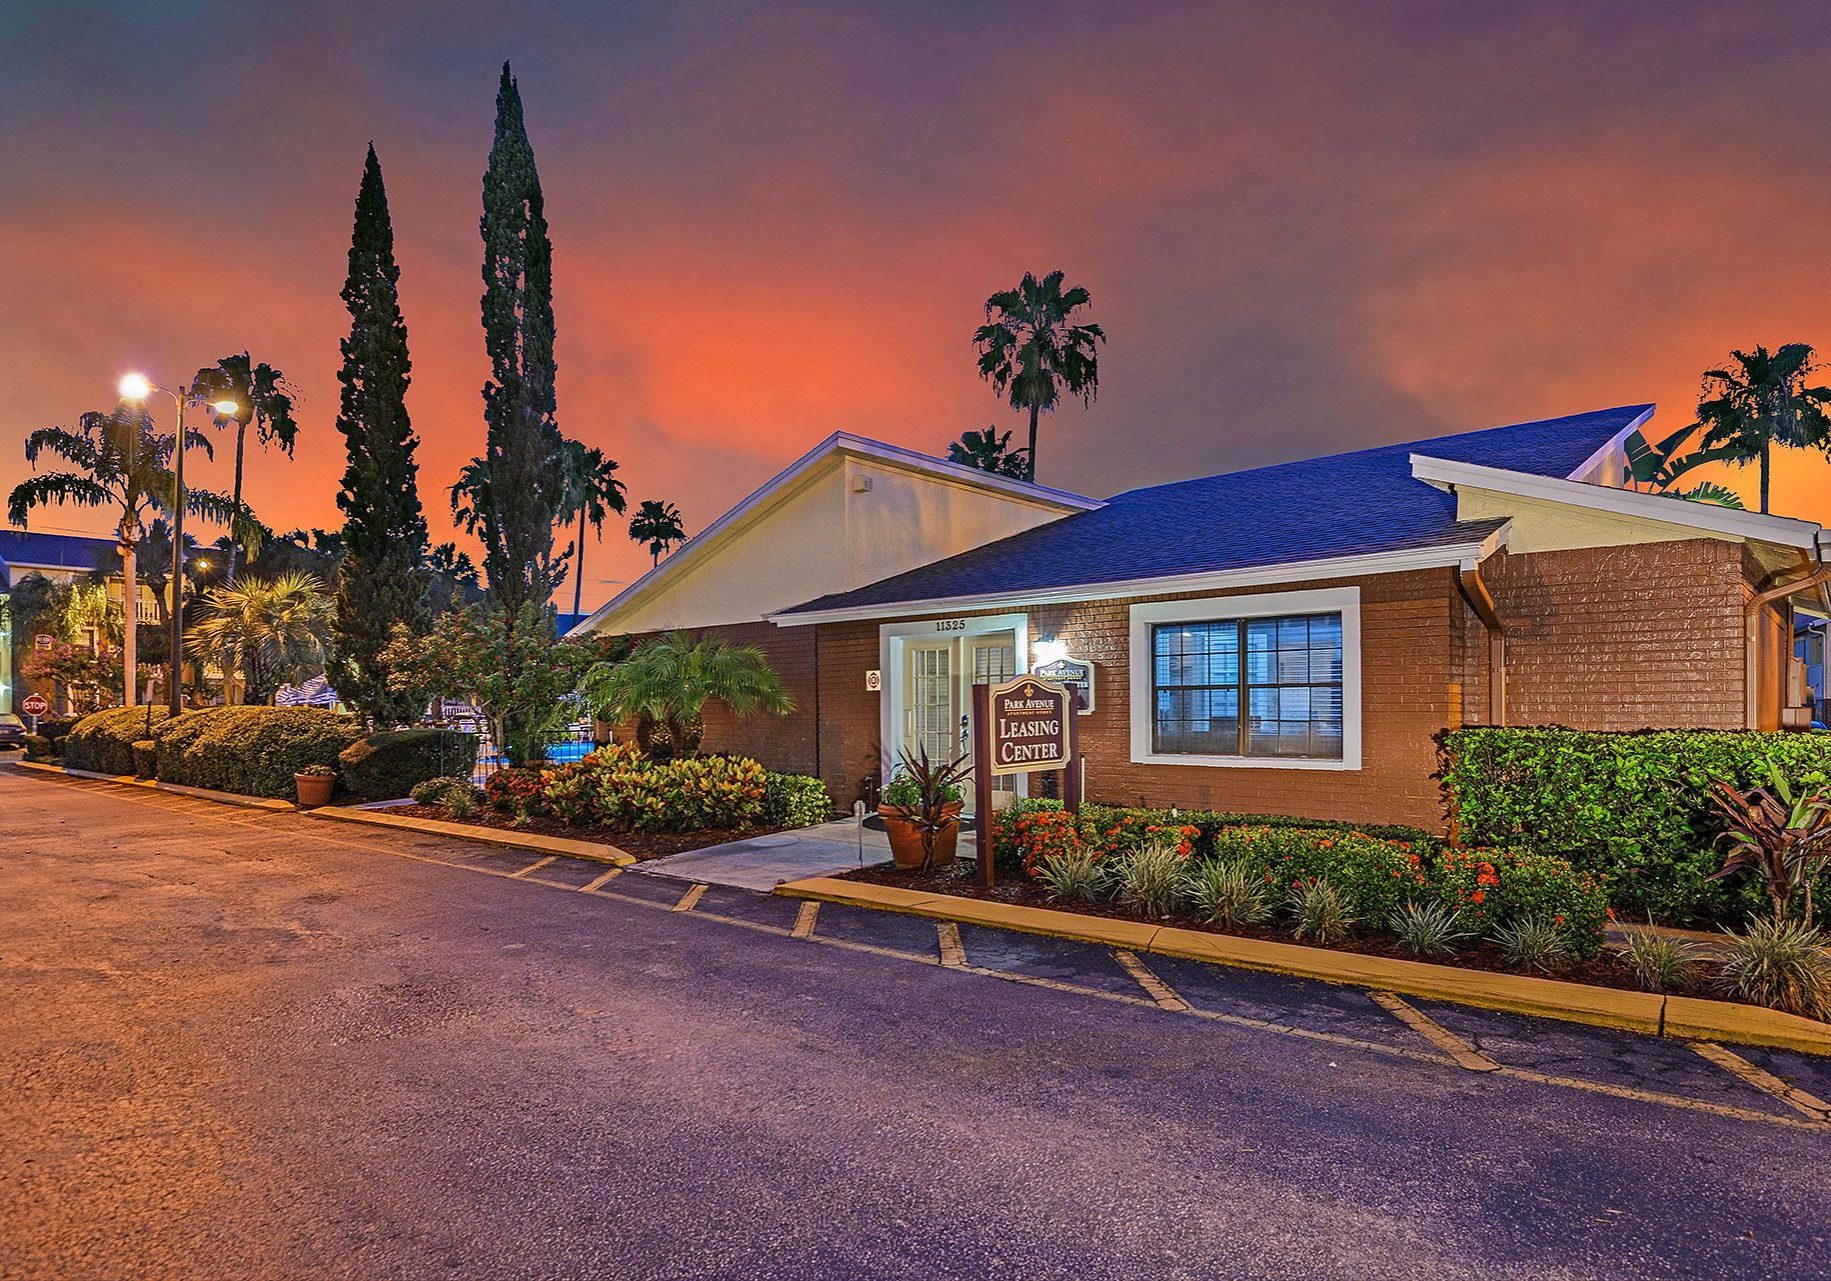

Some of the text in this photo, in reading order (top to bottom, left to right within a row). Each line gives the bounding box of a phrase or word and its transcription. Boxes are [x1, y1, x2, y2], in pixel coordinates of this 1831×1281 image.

[936, 619, 966, 631] 11325
[24, 701, 47, 711] STOP
[1004, 699, 1055, 709] PARK AVENUE
[999, 719, 1060, 739] LEASING
[1001, 742, 1058, 763] CENTER
